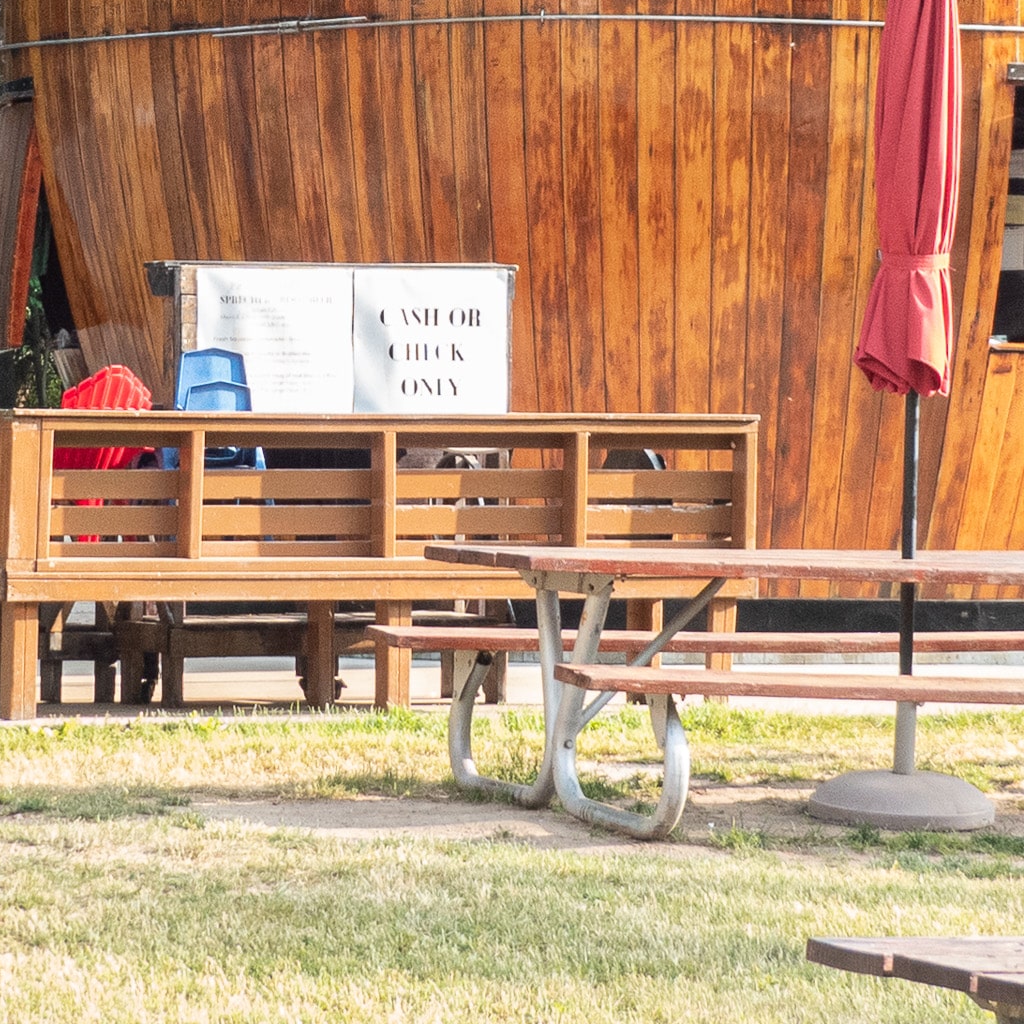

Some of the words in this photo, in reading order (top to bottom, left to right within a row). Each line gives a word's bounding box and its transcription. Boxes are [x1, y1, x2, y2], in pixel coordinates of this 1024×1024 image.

[379, 308, 441, 327] CASH
[449, 307, 482, 327] OR
[388, 343, 465, 362] CHECK
[401, 377, 460, 397] ONLY
